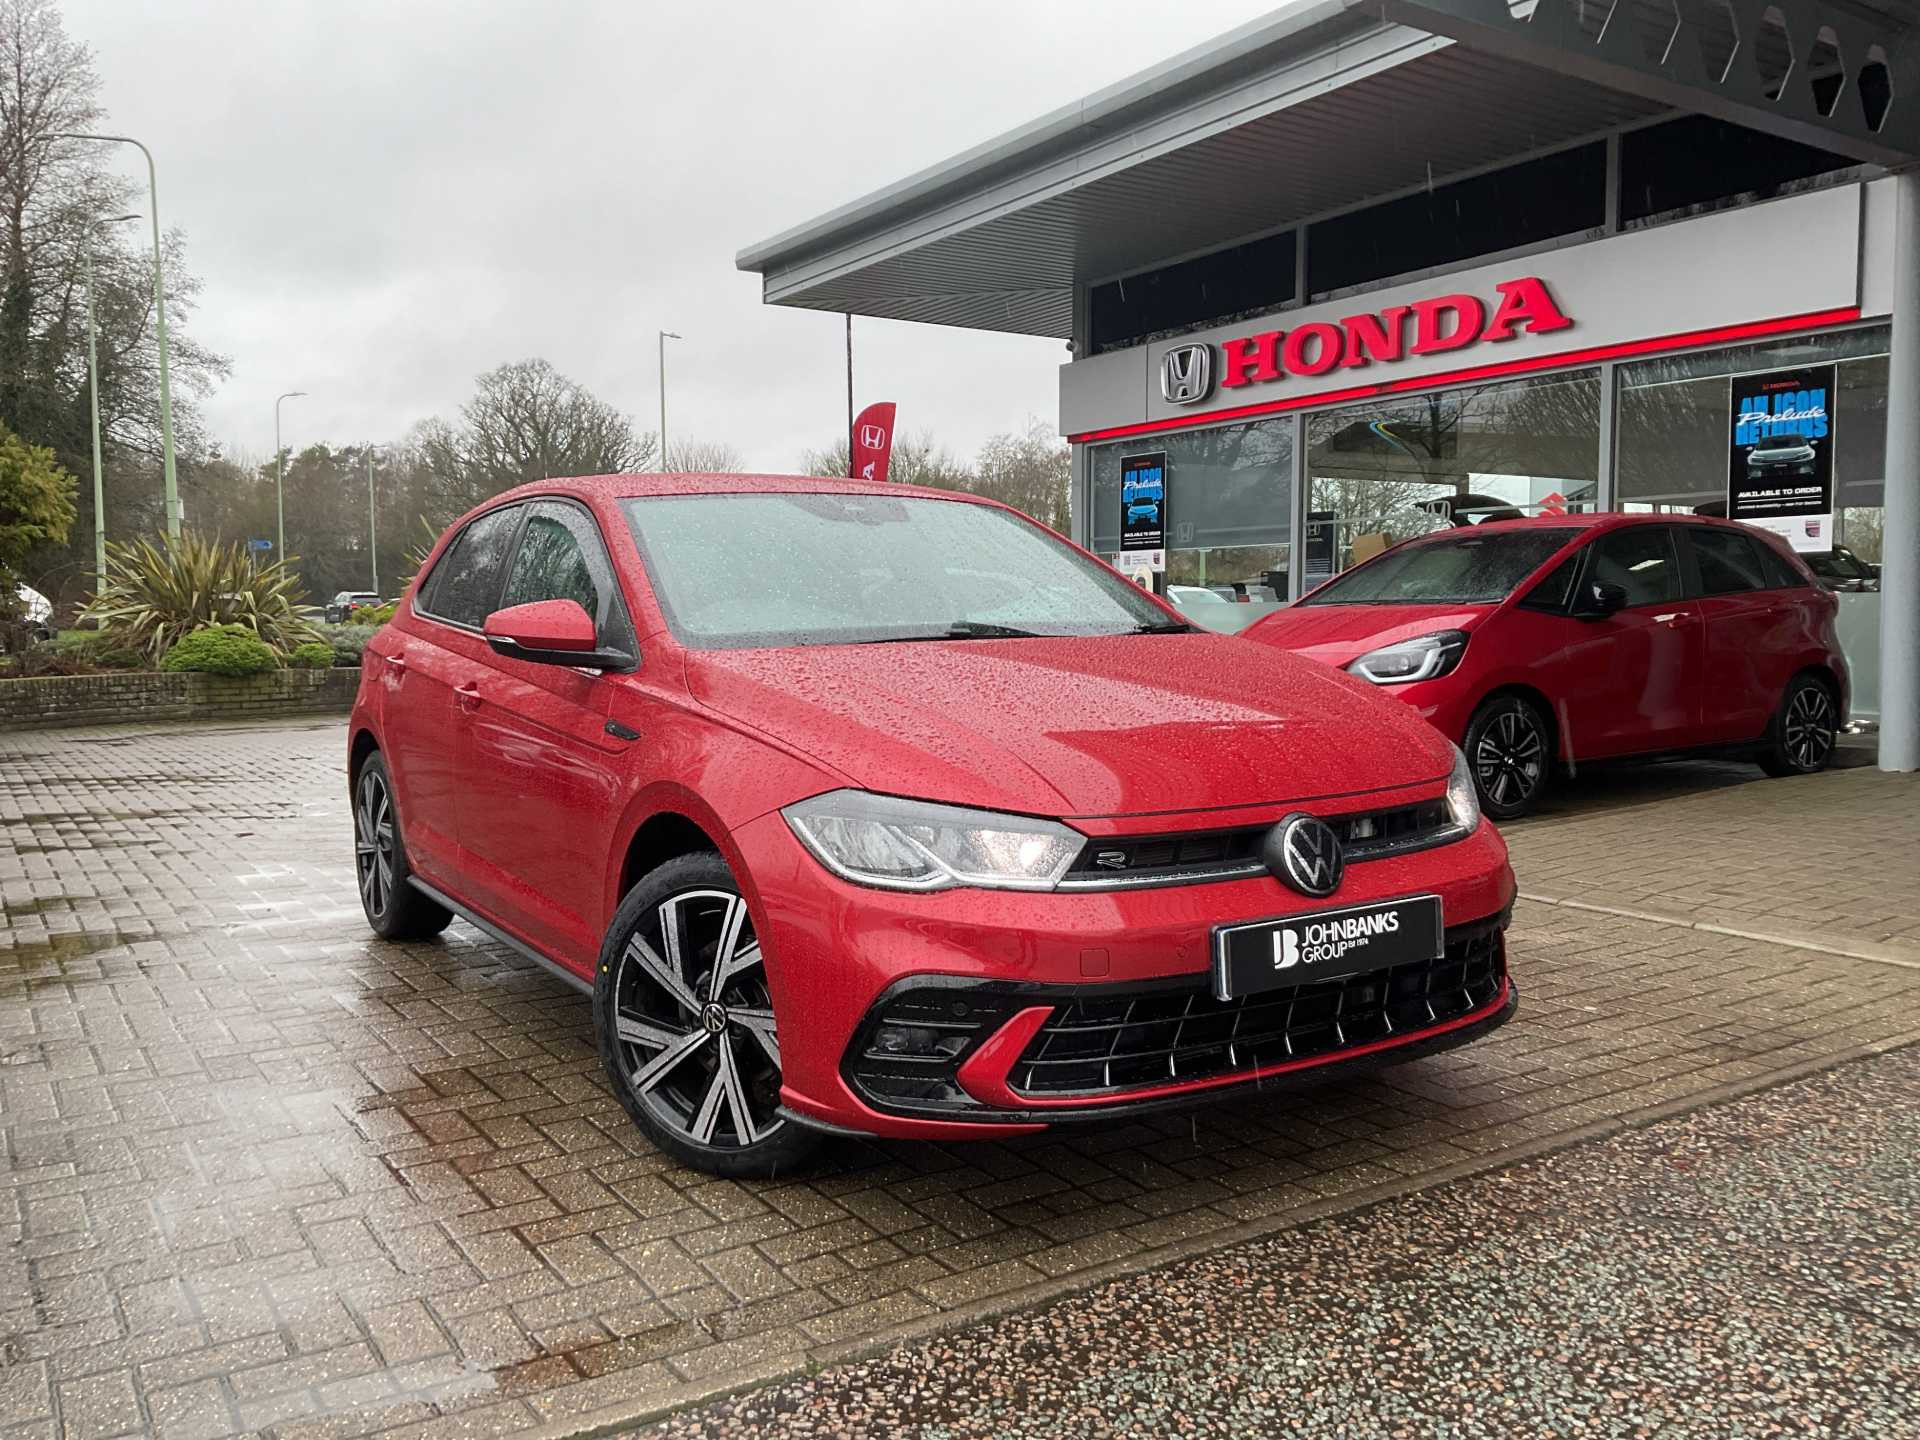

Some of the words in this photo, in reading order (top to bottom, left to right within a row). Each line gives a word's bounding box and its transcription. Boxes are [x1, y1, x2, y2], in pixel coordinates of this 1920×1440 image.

[1222, 276, 1573, 388] HONDA
[1737, 406, 1825, 426] Prelude
[1738, 489, 1780, 498] AVAILABLE
[1794, 486, 1822, 494] ORDER
[1301, 911, 1399, 947] JOHNBANKS
[1302, 941, 1348, 963] GROUP
[1356, 937, 1369, 946] 1974
